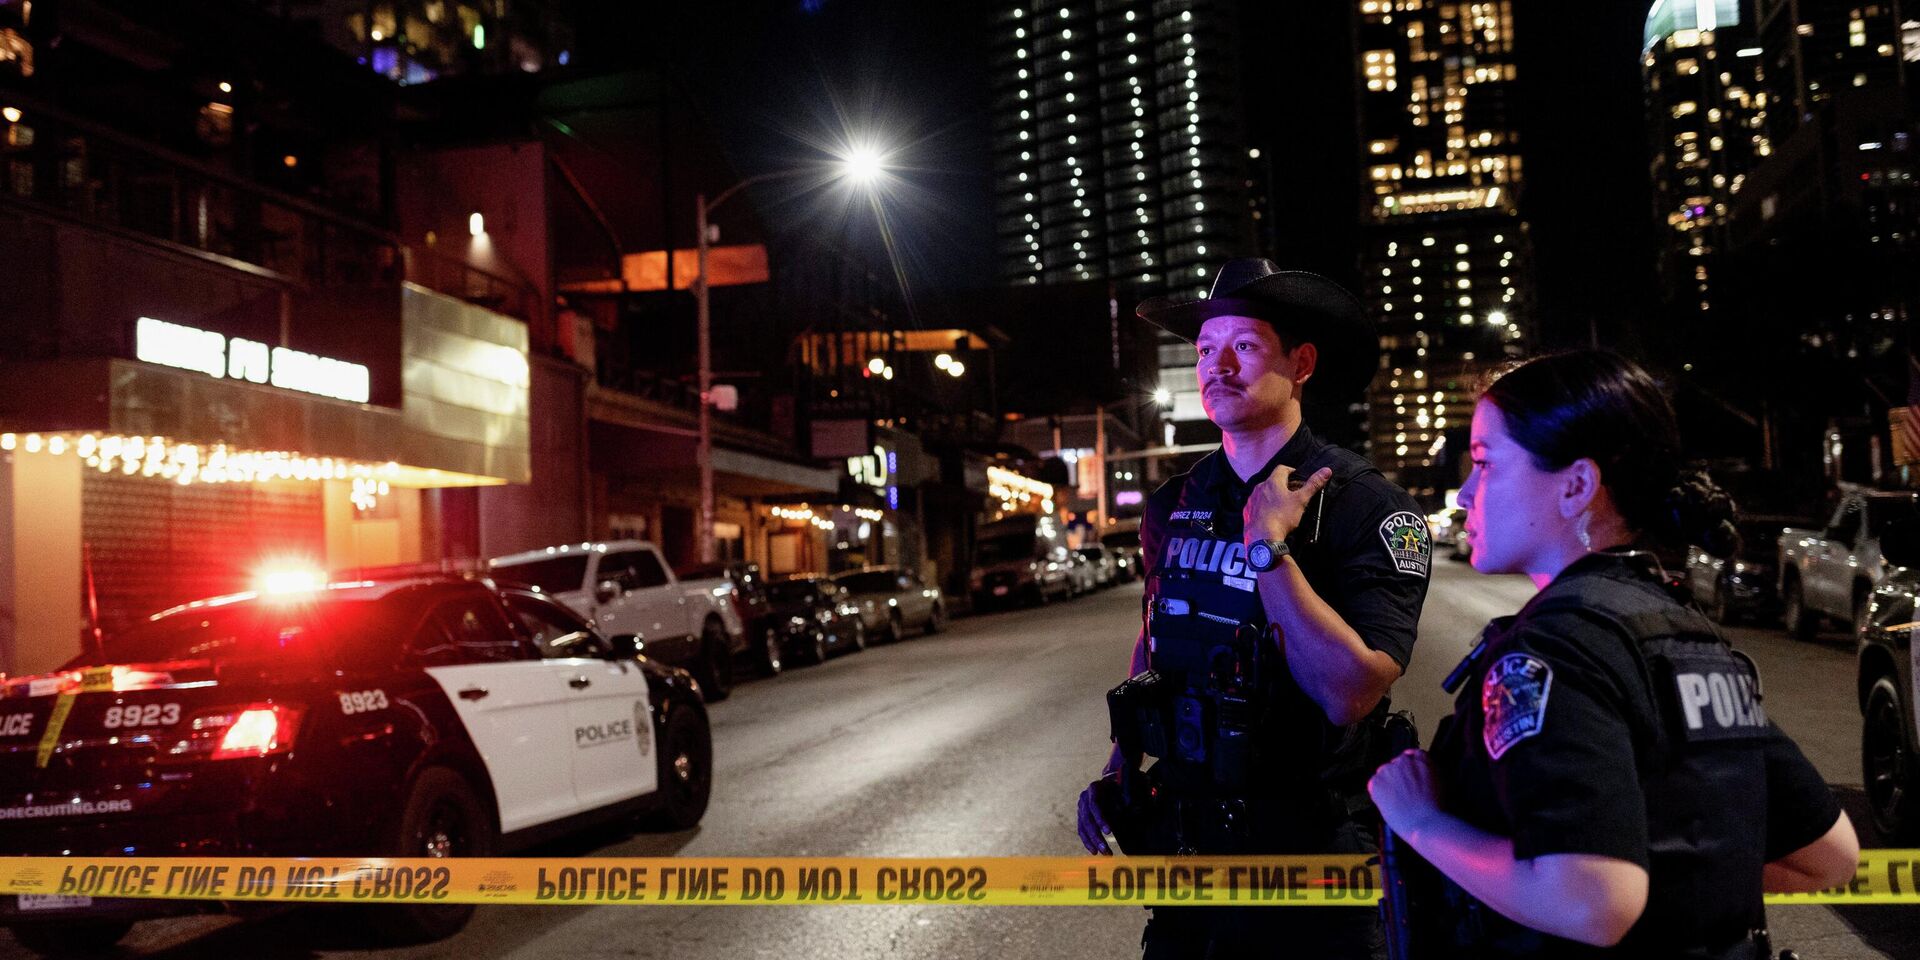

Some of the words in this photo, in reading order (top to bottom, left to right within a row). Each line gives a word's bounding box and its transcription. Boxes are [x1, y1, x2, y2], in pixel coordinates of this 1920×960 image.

[1400, 560, 1425, 572] AUSTIN
[339, 689, 389, 715] 8923
[104, 703, 181, 729] 8923
[575, 719, 631, 744] POLICE
